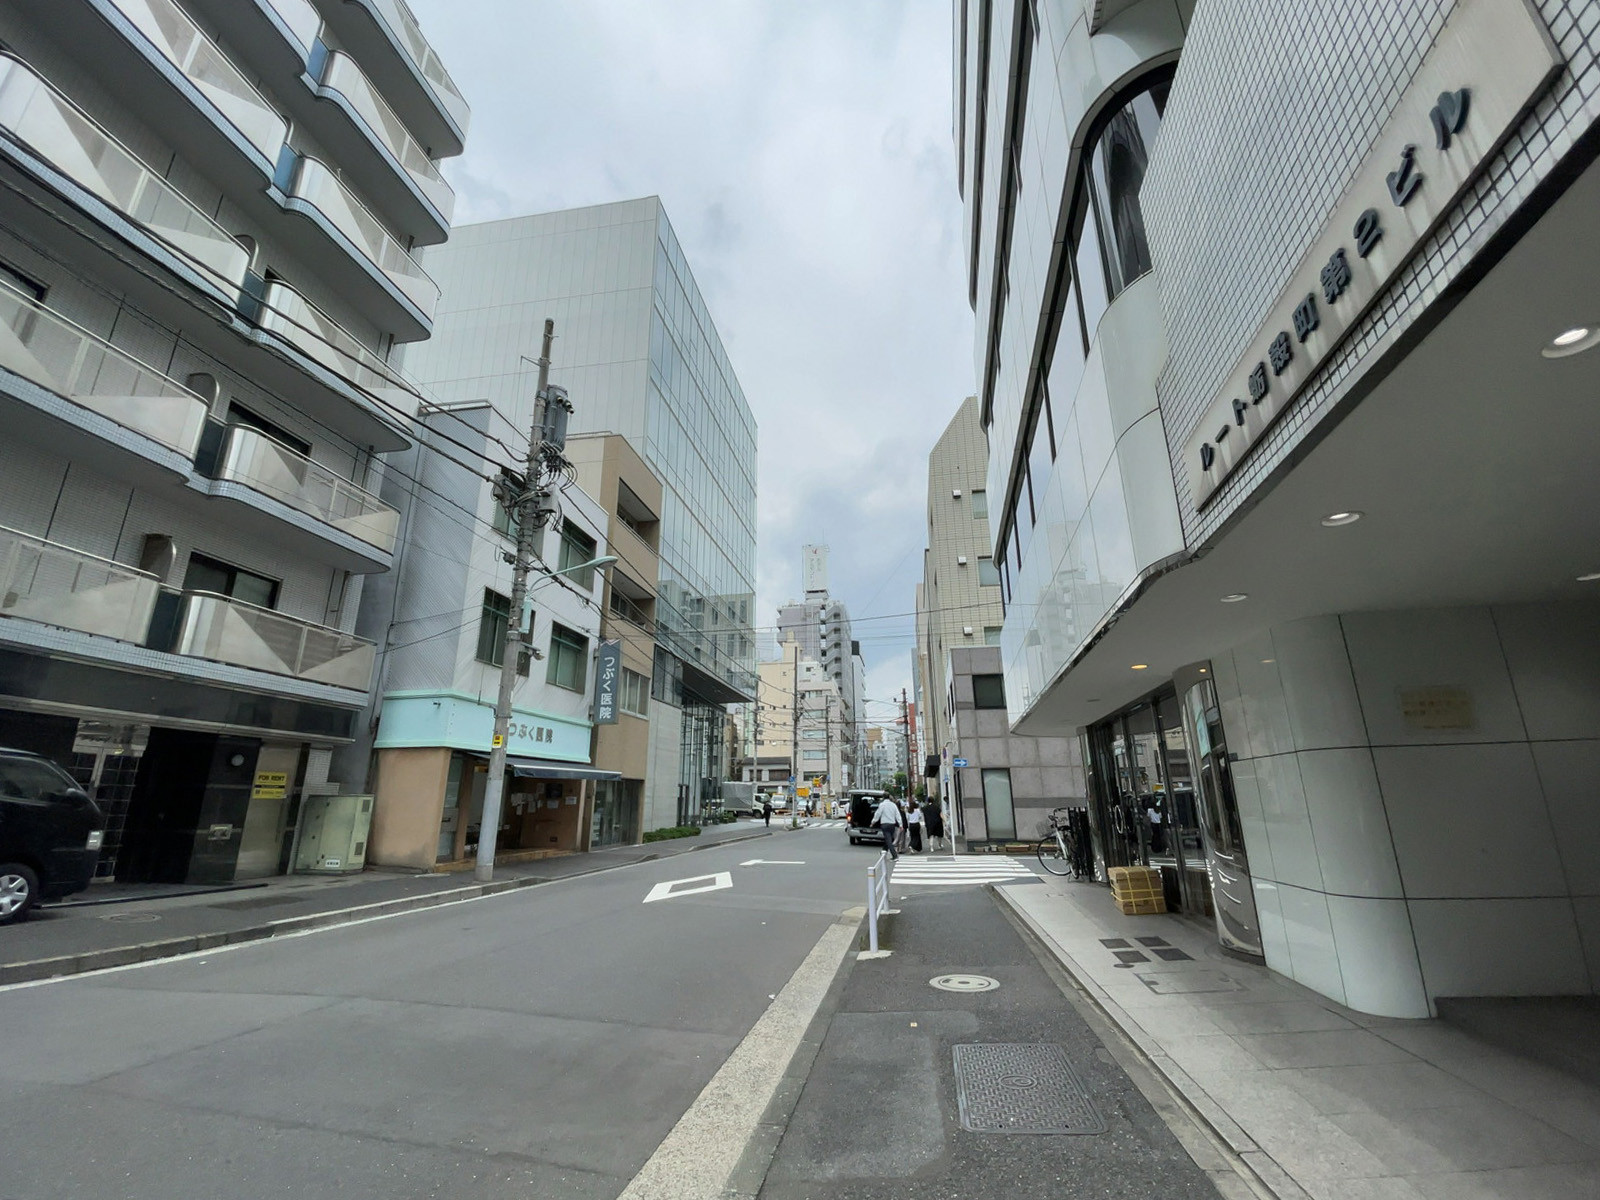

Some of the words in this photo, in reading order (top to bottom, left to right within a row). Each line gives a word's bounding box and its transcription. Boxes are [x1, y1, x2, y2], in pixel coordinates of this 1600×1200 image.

[599, 656, 615, 720] つぶく医院
